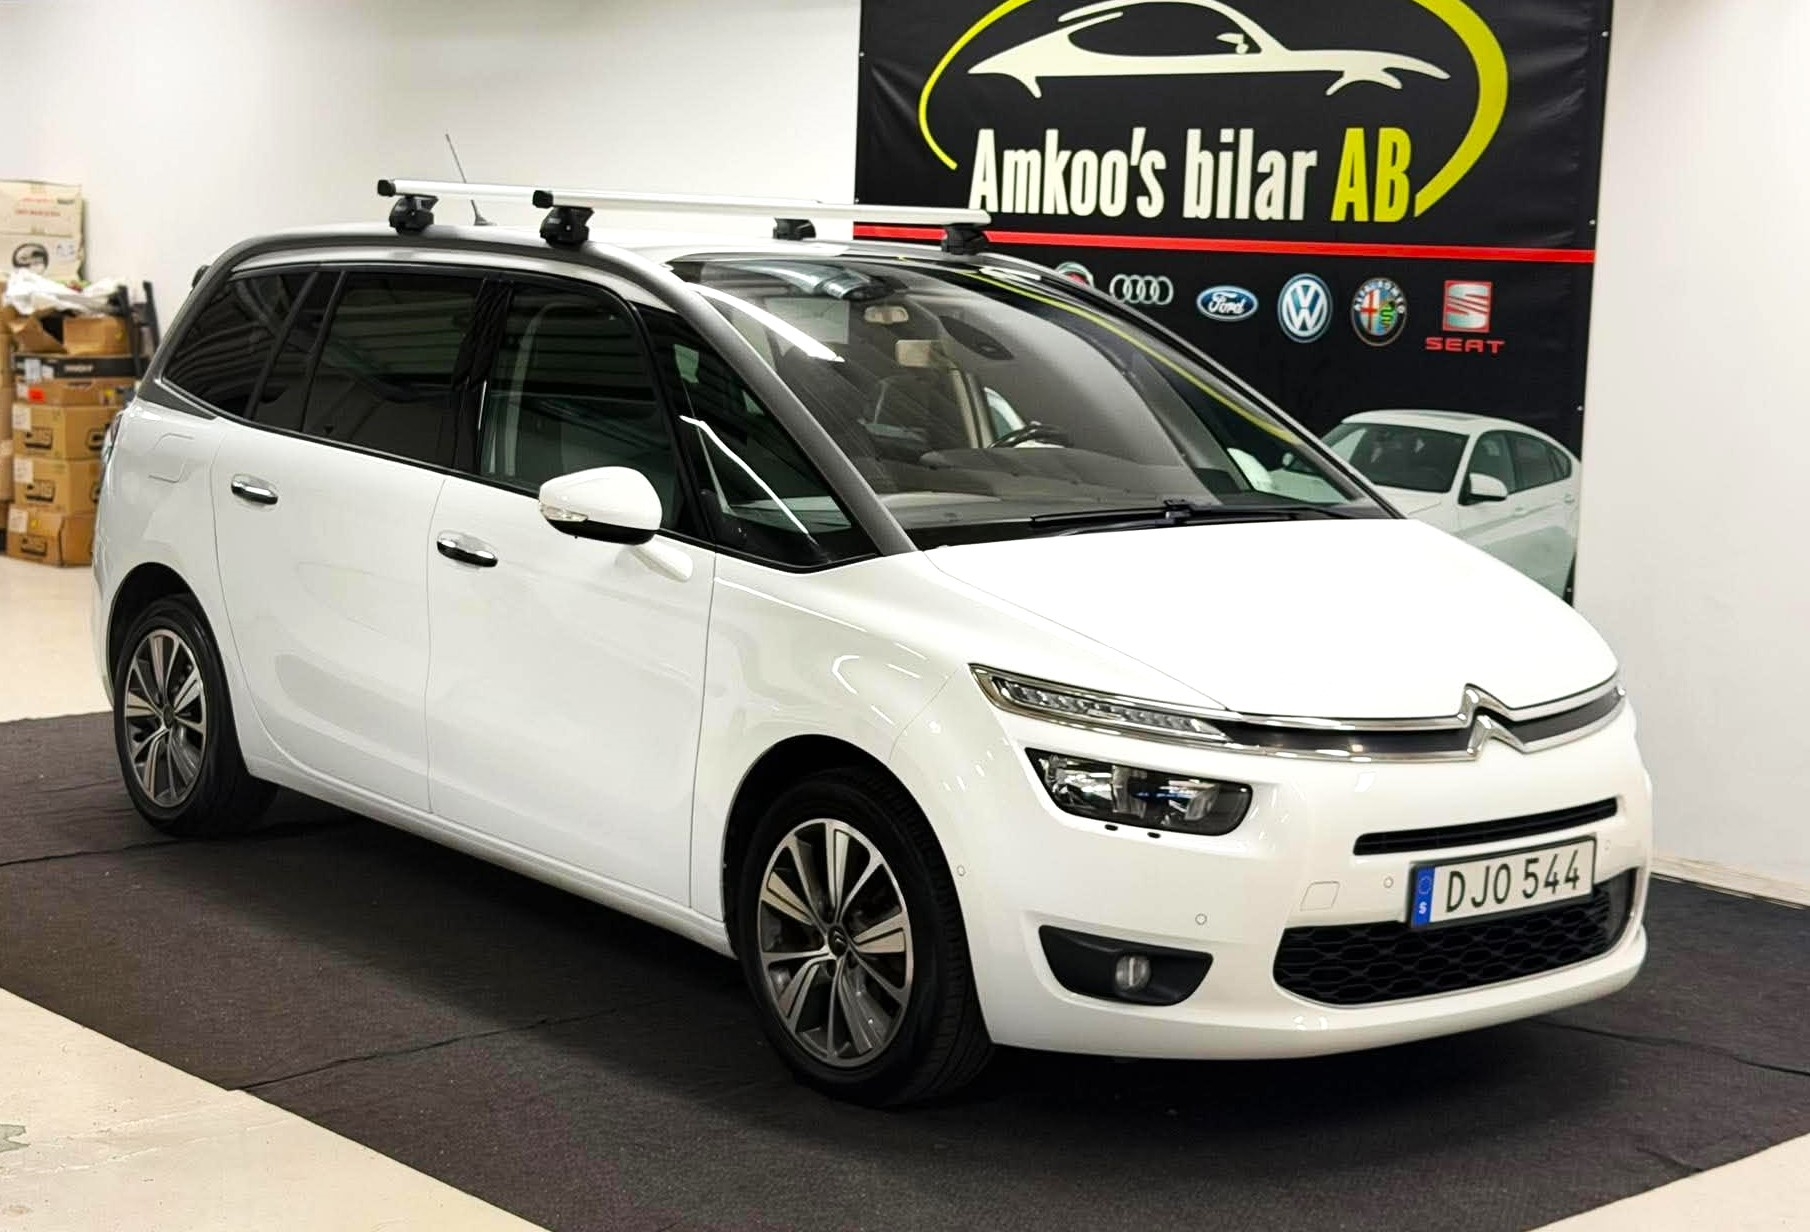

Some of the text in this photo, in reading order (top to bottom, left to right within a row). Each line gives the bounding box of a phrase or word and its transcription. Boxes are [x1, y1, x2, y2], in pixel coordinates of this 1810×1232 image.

[968, 127, 1412, 223] Amkoo's bilar AB
[1208, 292, 1247, 315] Ford
[1425, 336, 1505, 354] SEAT
[1446, 850, 1580, 913] DJO 544
[1418, 901, 1428, 915] S
